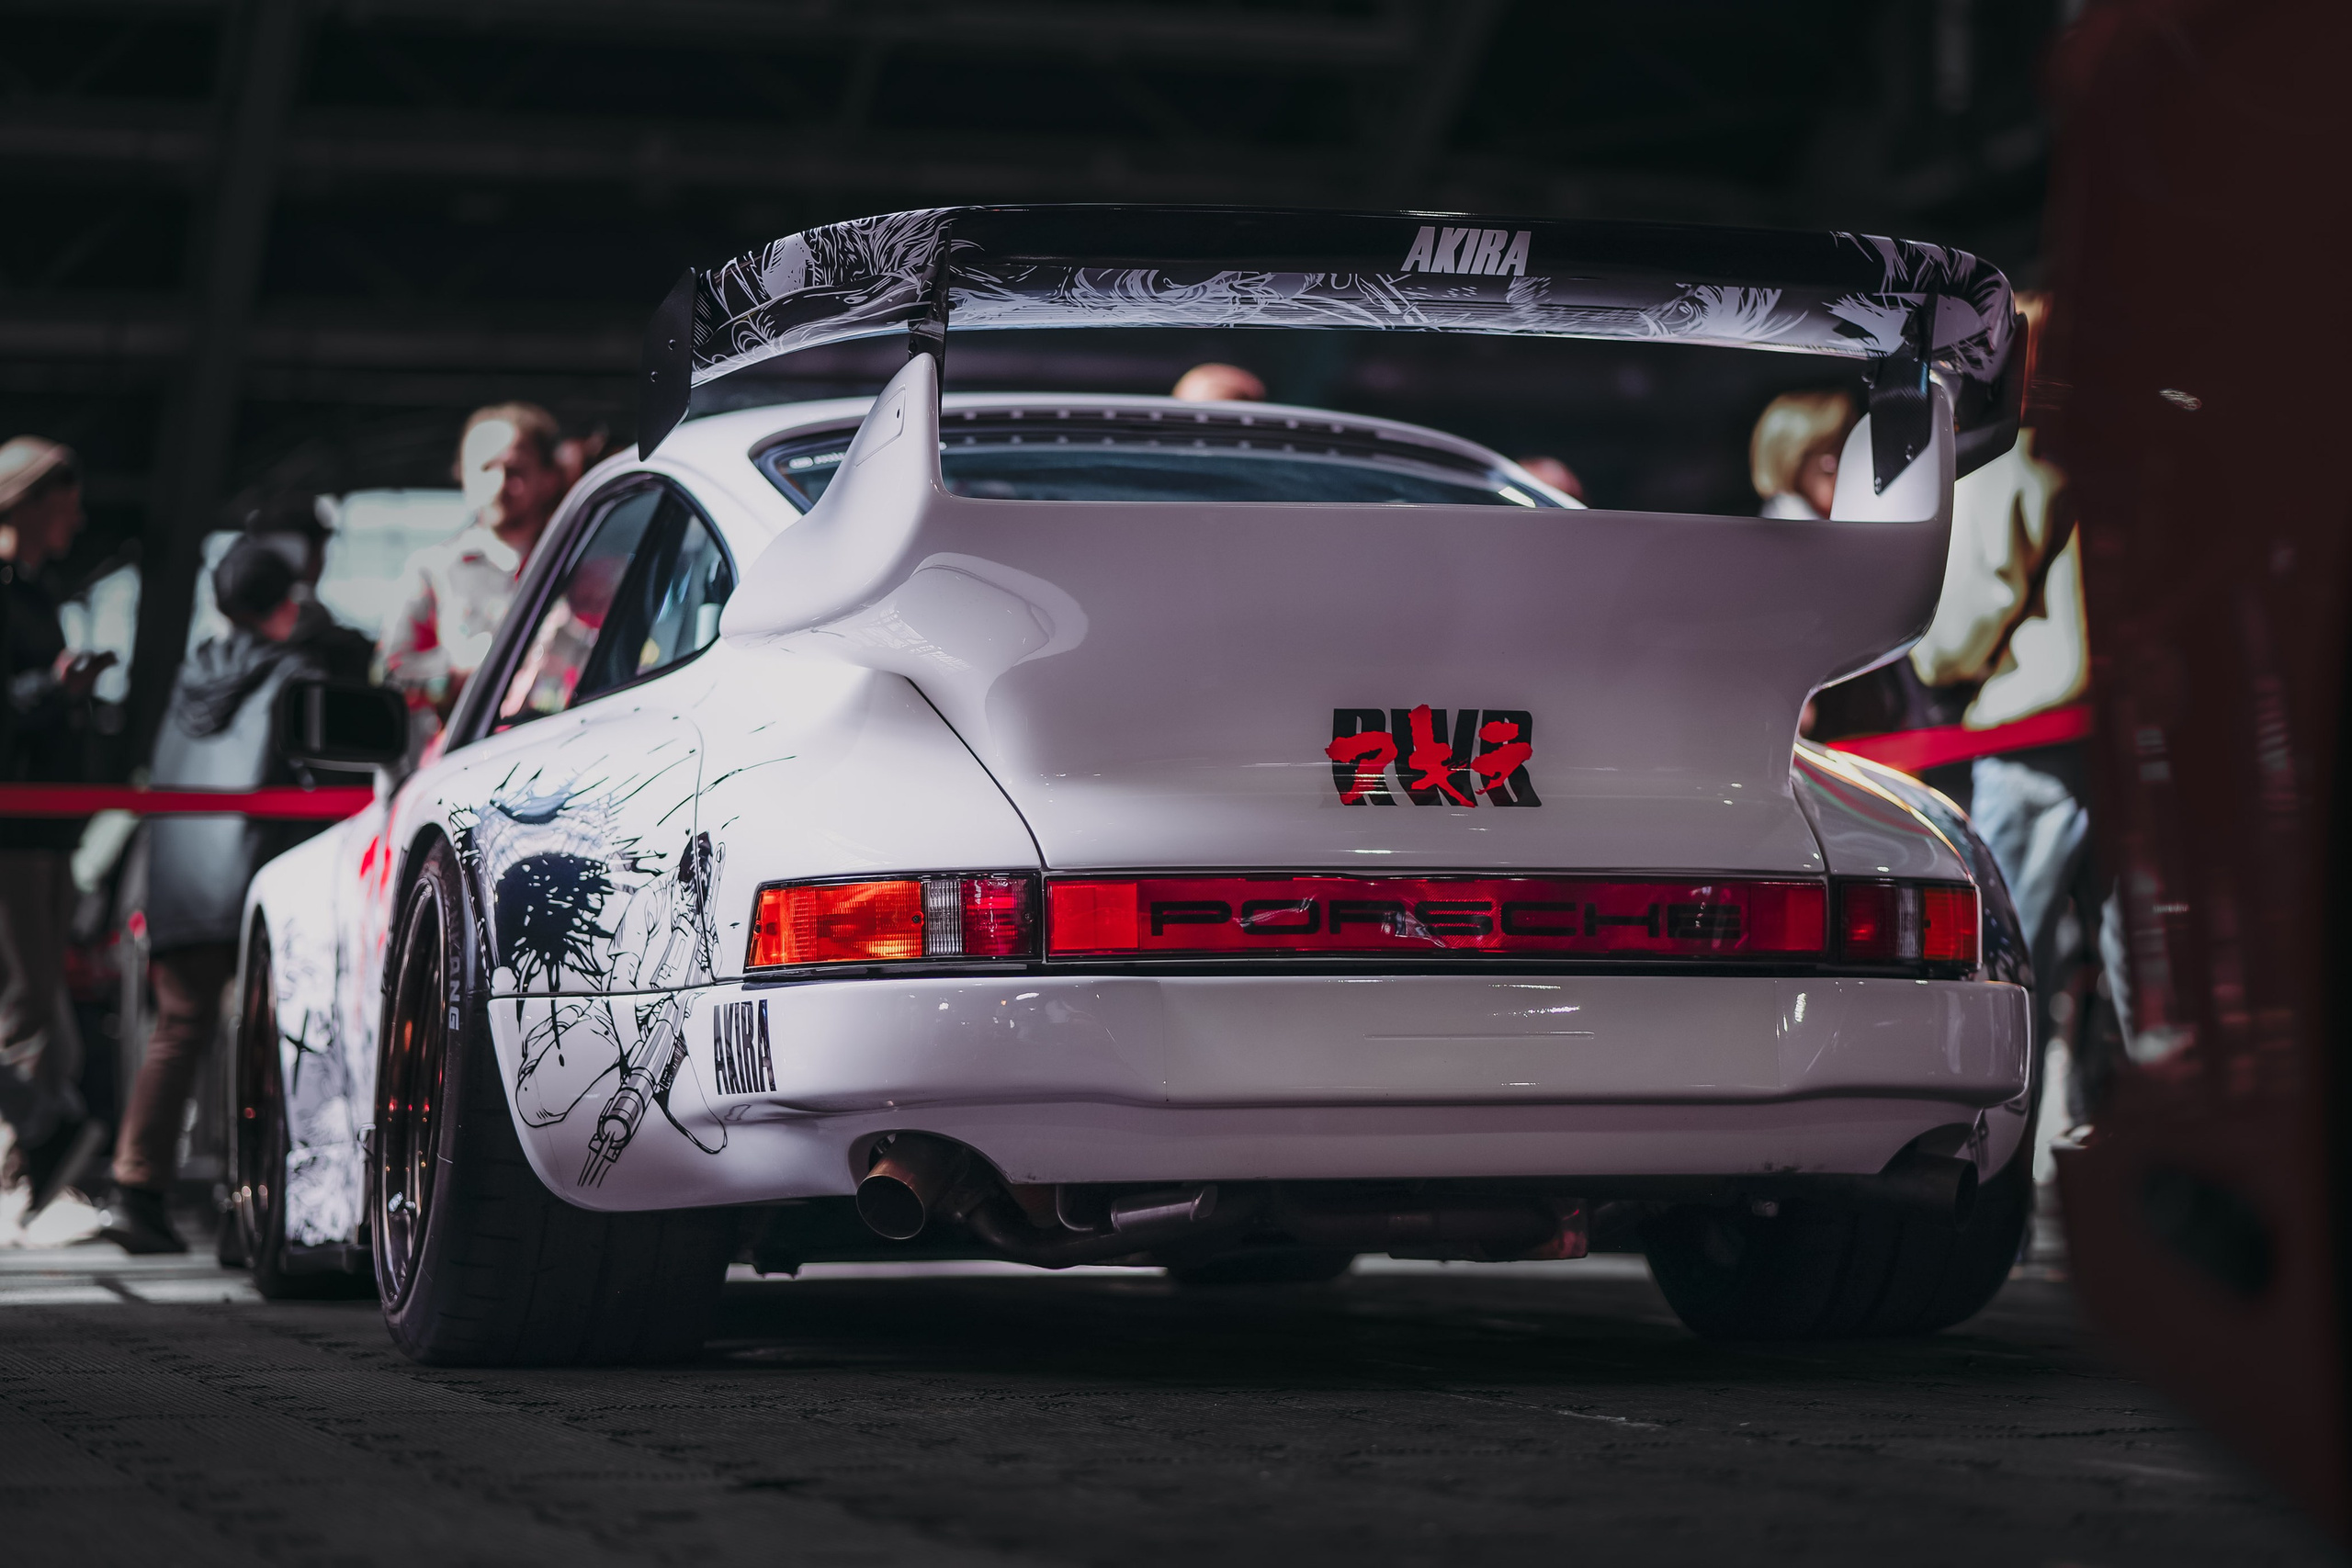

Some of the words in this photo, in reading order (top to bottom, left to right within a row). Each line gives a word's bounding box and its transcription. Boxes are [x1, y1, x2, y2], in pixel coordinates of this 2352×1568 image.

[1401, 226, 1532, 276] AKIRA
[1150, 898, 1743, 939] PORSCHE
[714, 998, 777, 1095] AKIRA
